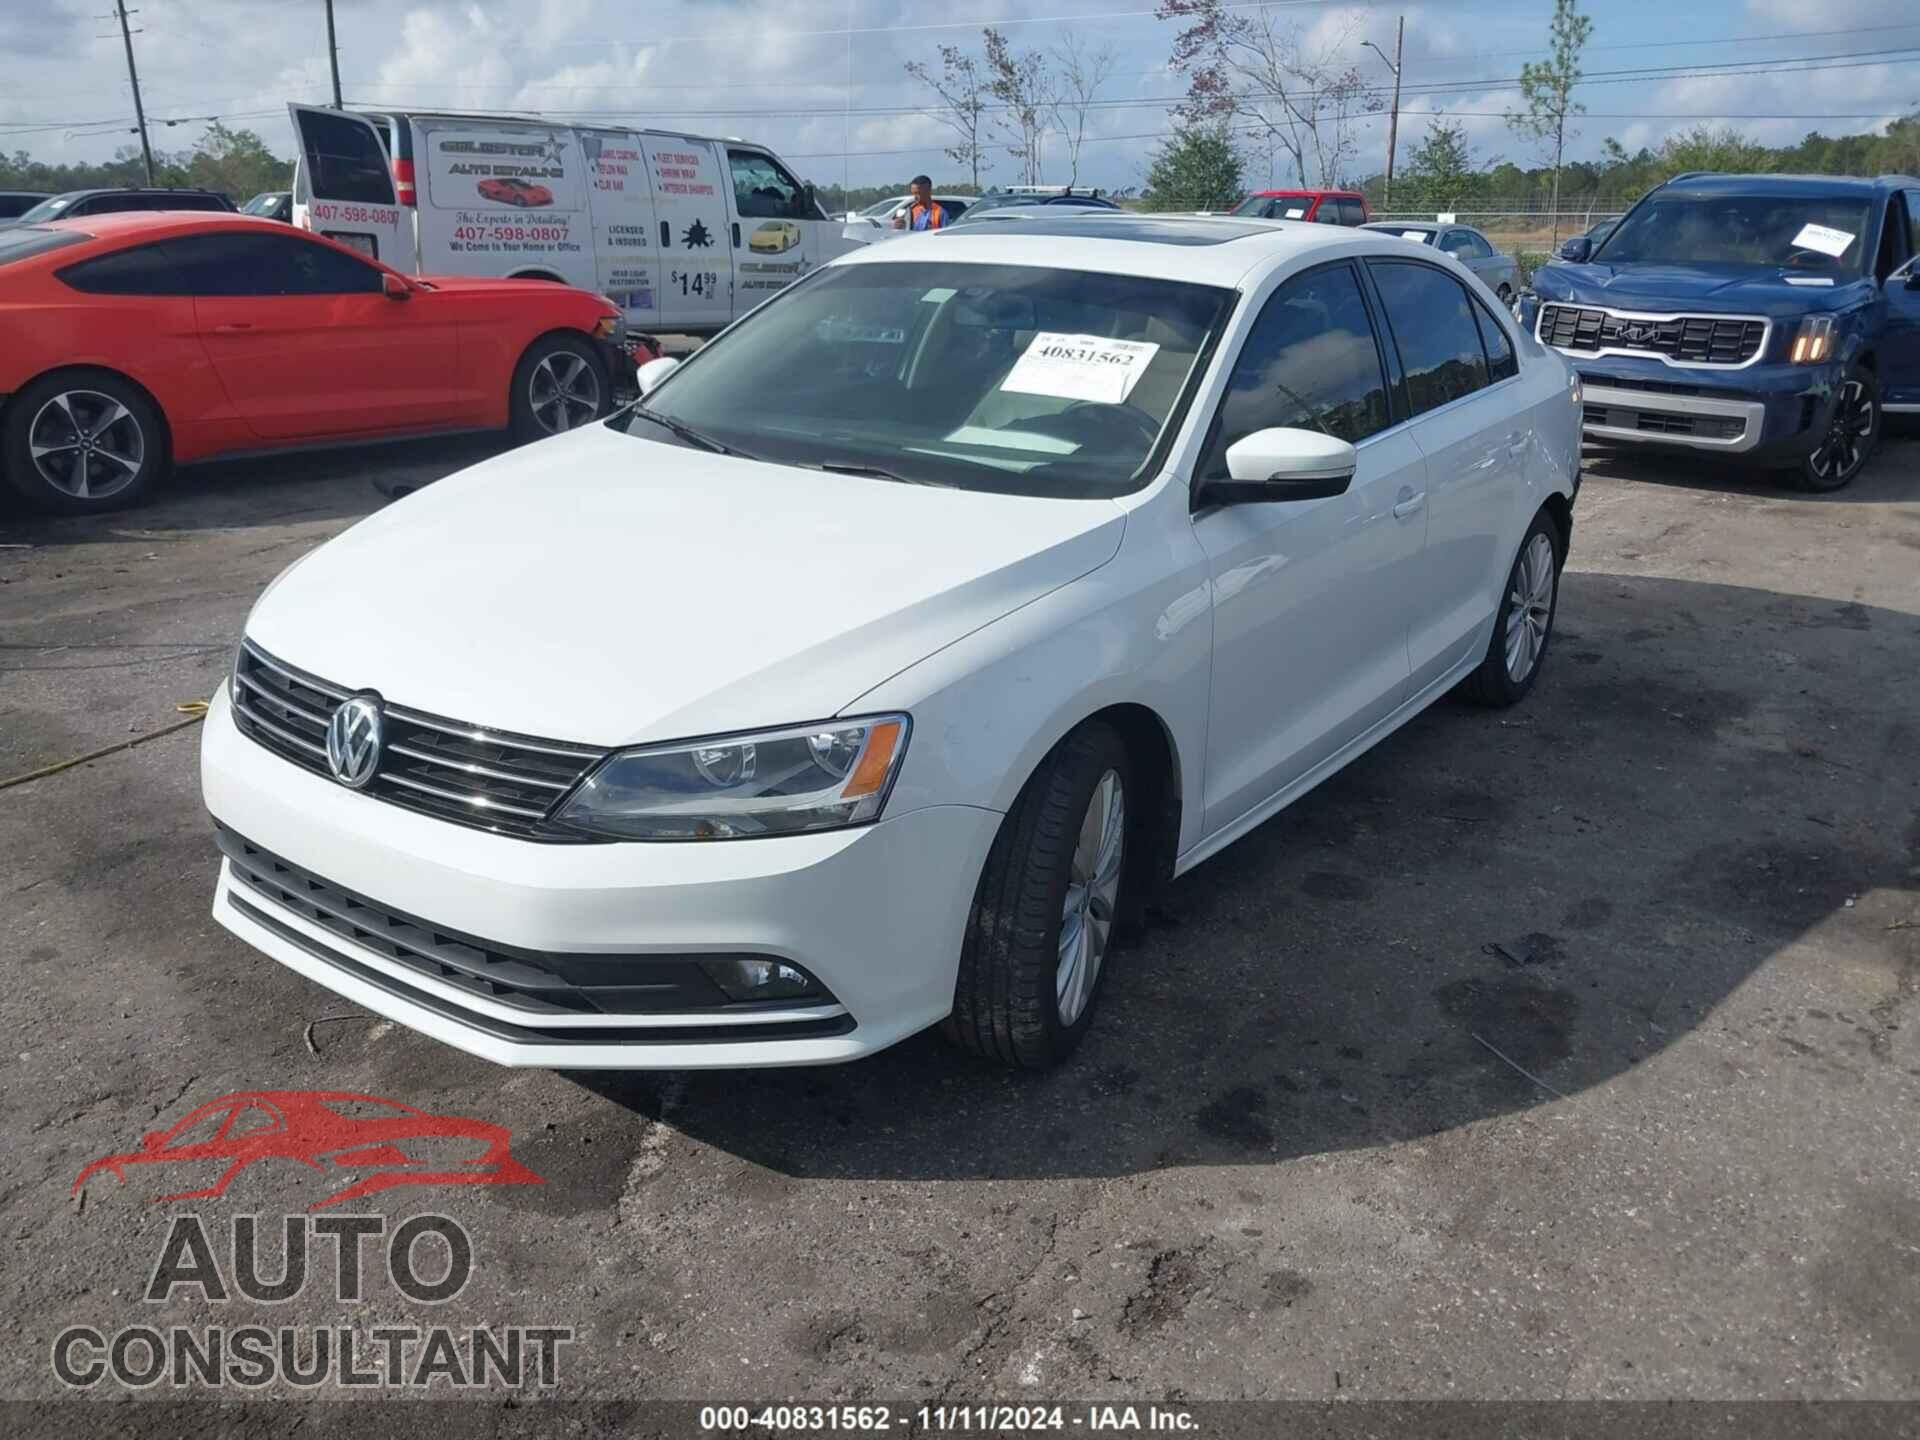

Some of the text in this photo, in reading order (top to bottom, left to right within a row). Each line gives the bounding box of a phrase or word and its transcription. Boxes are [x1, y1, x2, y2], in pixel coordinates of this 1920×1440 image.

[448, 163, 491, 175] AUTO
[455, 212, 475, 223] The
[454, 226, 570, 241] 407-598-0807
[608, 225, 644, 235] LICENSED
[449, 241, 463, 251] We
[466, 242, 490, 251] Come
[492, 242, 500, 251] to
[503, 242, 521, 251] Your
[523, 242, 545, 251] Home
[557, 242, 581, 252] Office
[607, 237, 647, 247] & INSURED
[1039, 345, 1135, 366] 40831562
